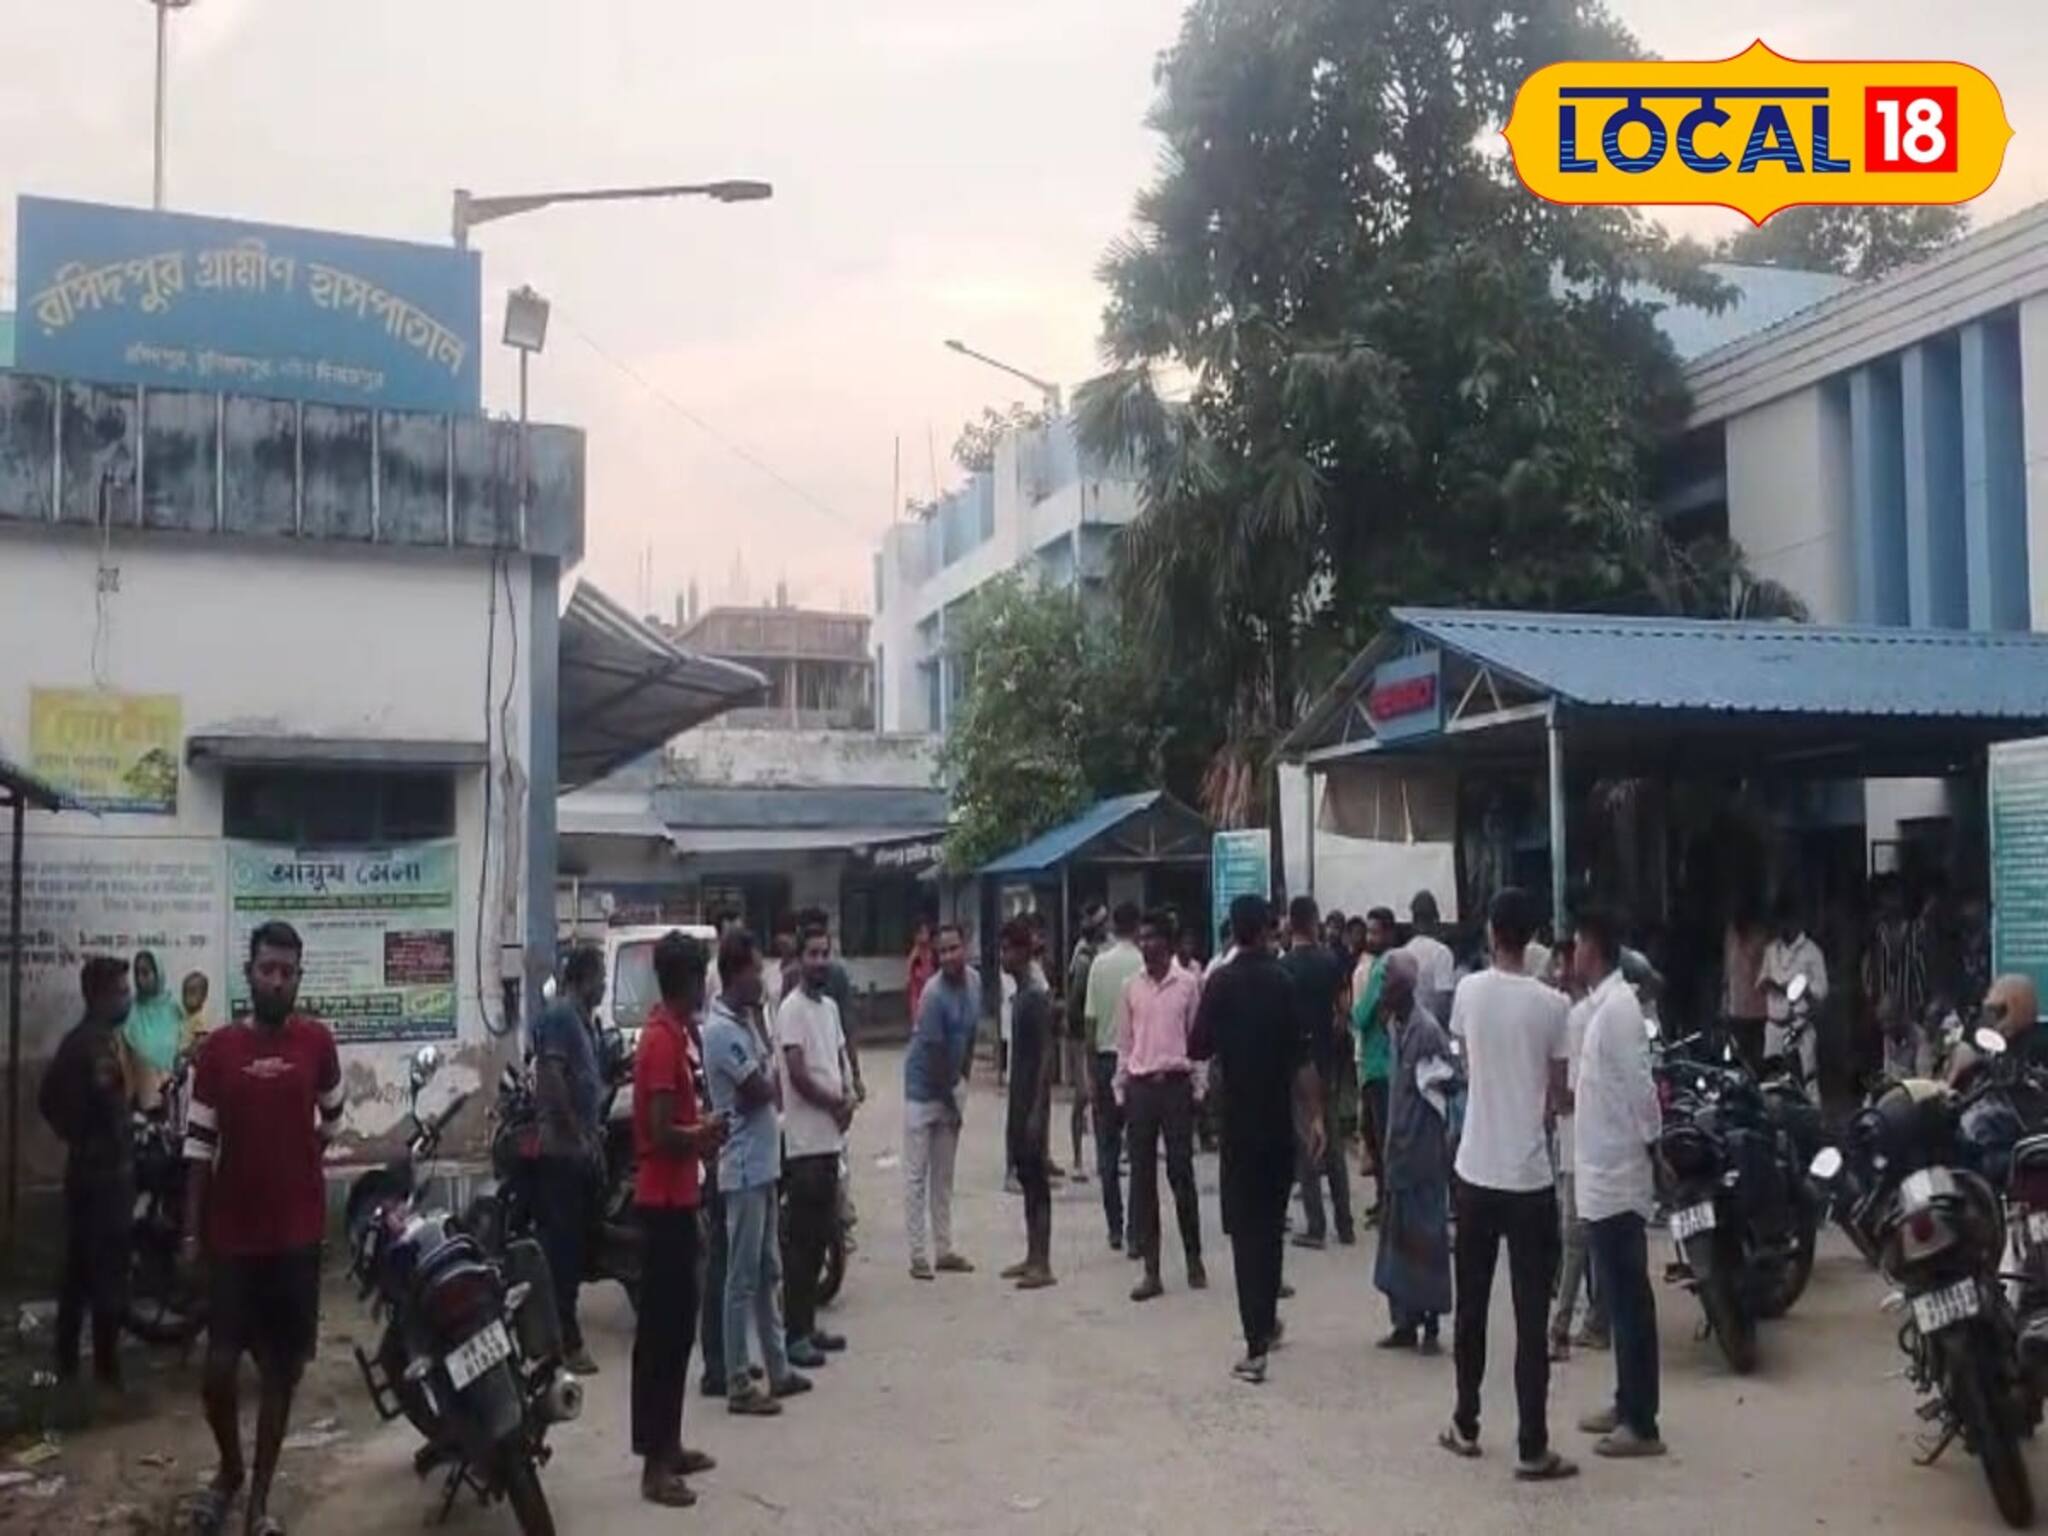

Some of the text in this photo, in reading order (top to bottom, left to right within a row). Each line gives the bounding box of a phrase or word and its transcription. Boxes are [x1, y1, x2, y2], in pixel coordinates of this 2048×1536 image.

[32, 250, 185, 335] রসিদপুর
[197, 238, 296, 295] গ্রামীণ
[306, 262, 467, 374] হাসপাতাল
[356, 861, 421, 886] মেলা
